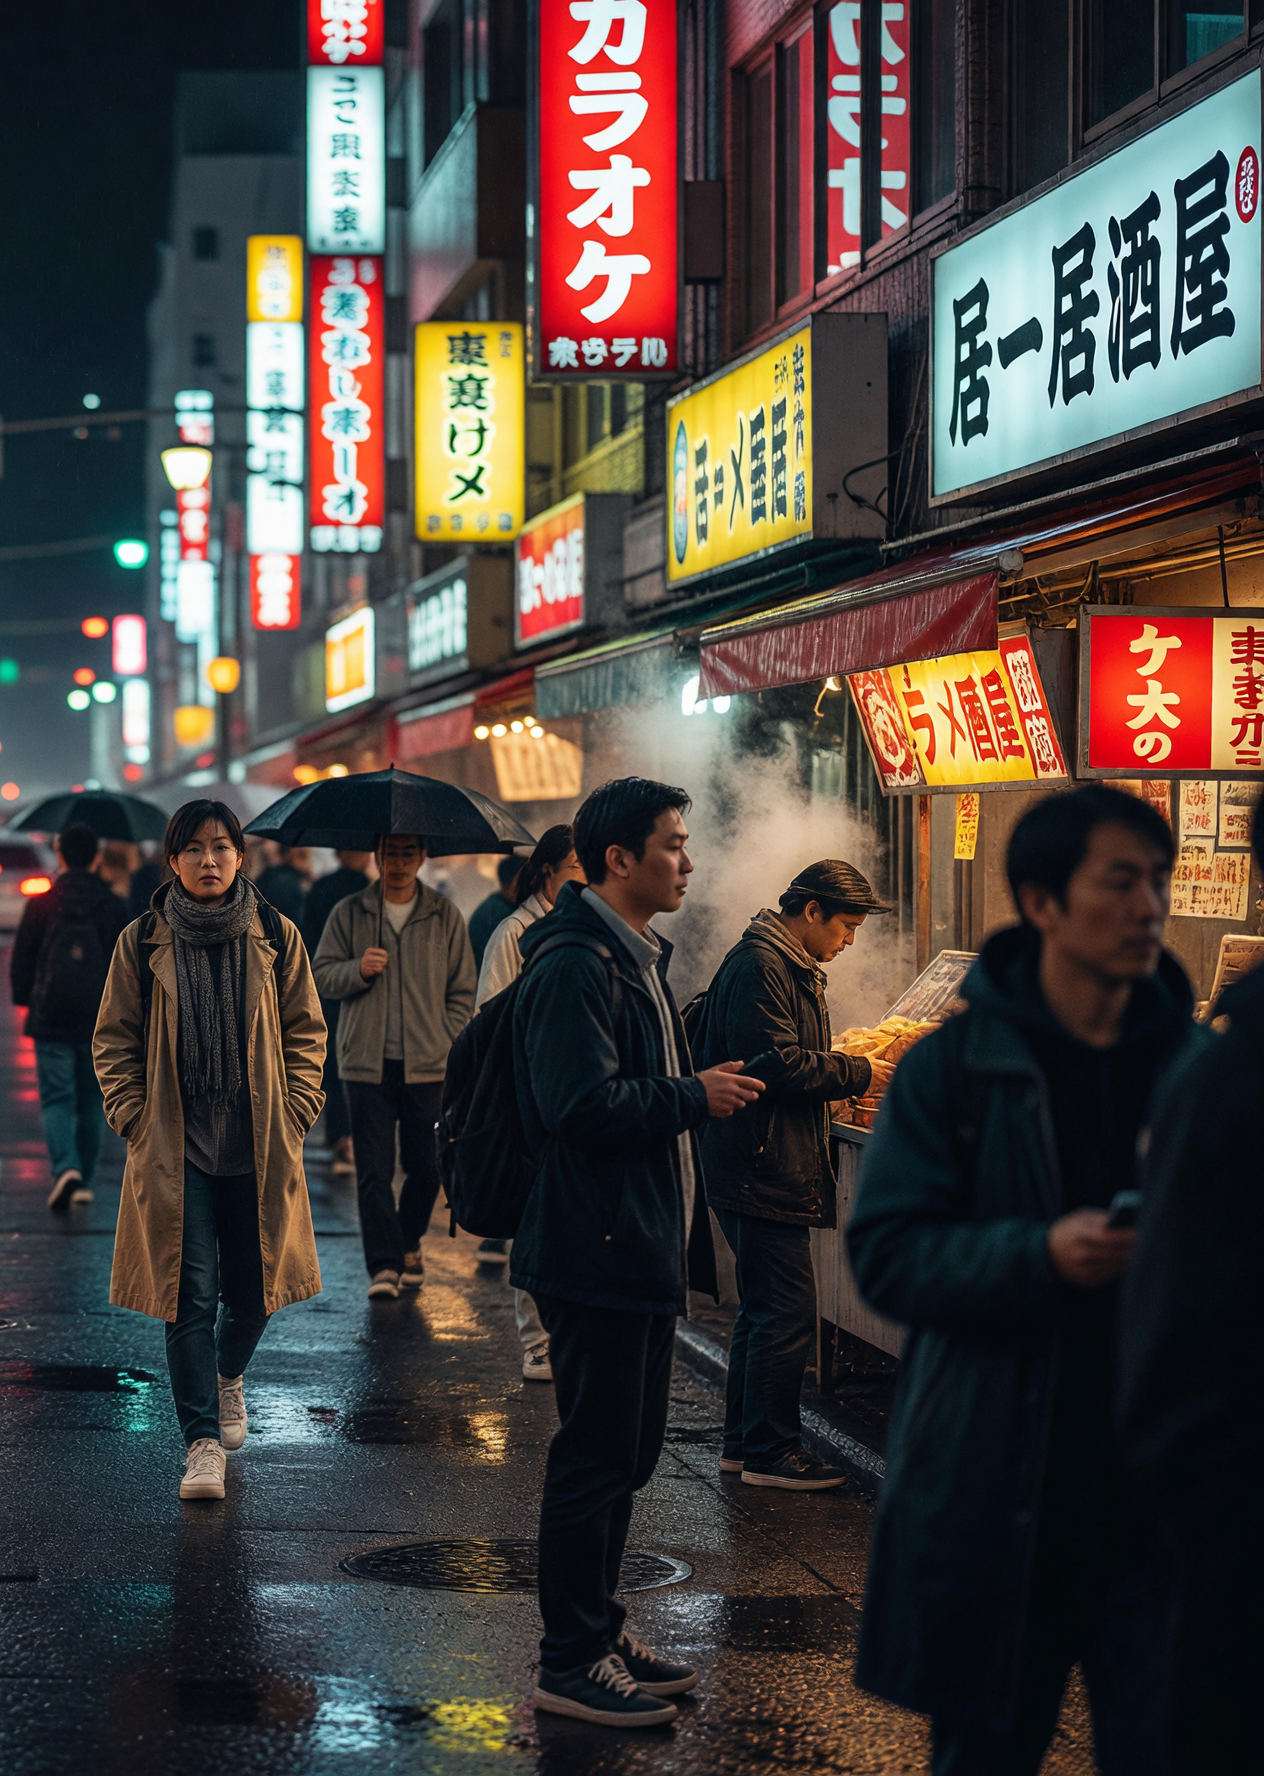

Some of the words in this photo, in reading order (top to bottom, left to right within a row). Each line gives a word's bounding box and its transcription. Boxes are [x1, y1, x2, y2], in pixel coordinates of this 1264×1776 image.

[565, 0, 651, 323] カラオケ
[1125, 624, 1182, 764] ケ大の
